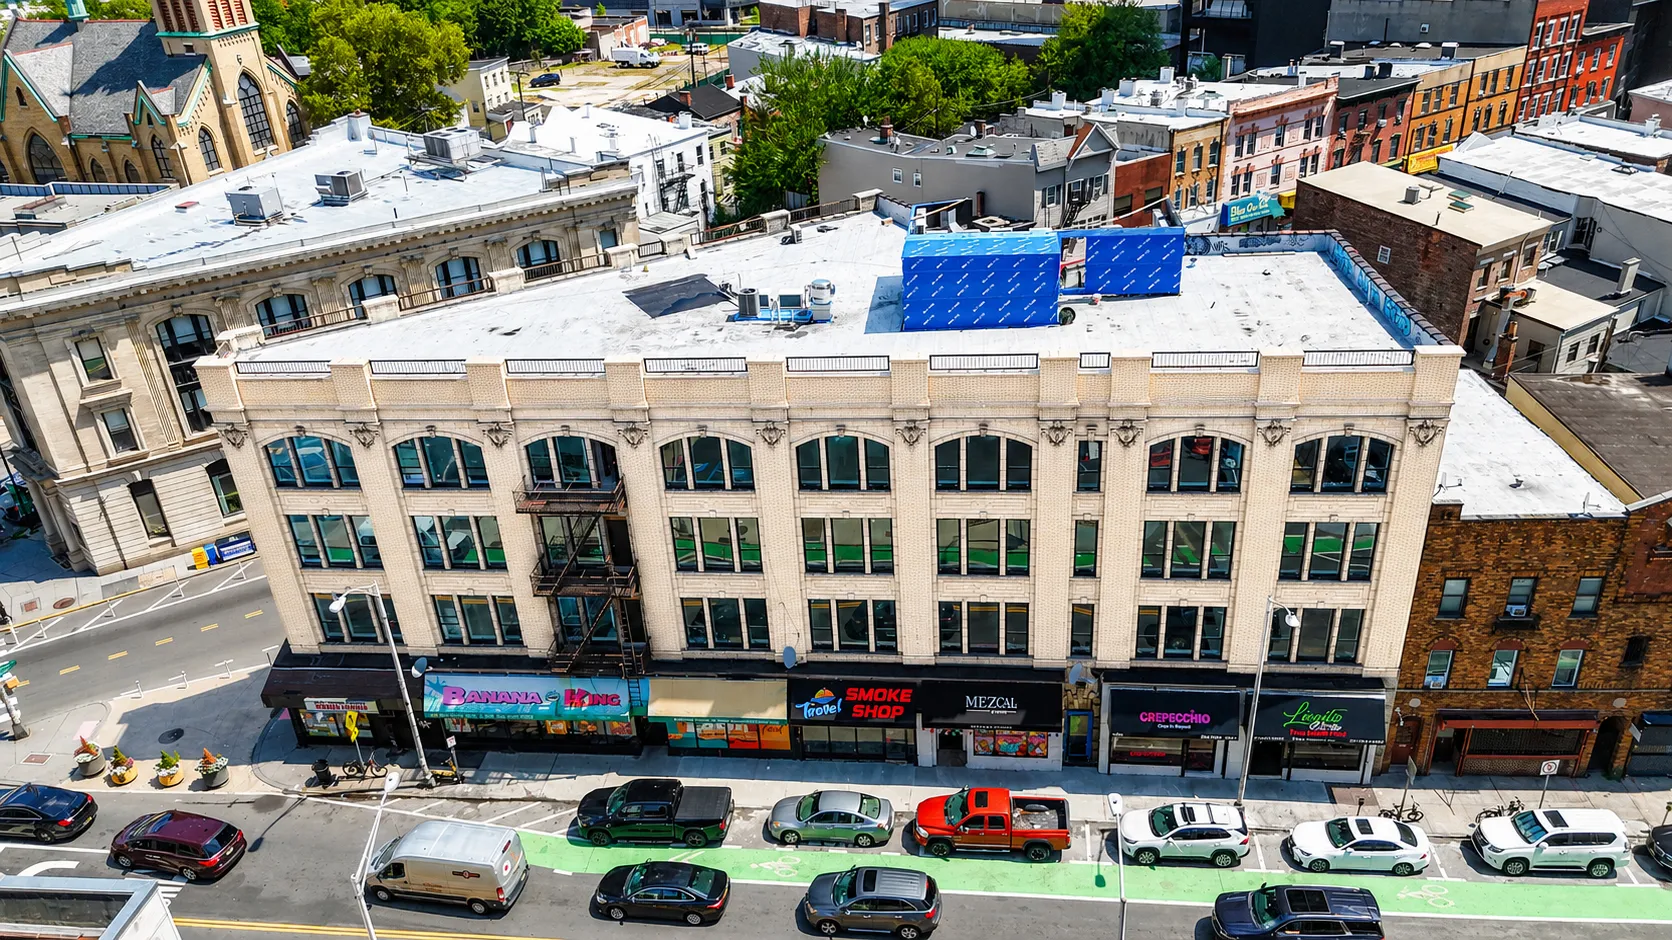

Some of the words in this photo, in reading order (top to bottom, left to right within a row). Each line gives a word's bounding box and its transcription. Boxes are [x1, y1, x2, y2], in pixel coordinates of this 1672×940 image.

[443, 686, 543, 706] BANANA
[564, 688, 621, 708] KING
[845, 687, 913, 703] SMOKE
[965, 695, 1018, 709] MEZCAL
[851, 704, 905, 719] SHOP
[1139, 709, 1211, 724] CREPECCHIO
